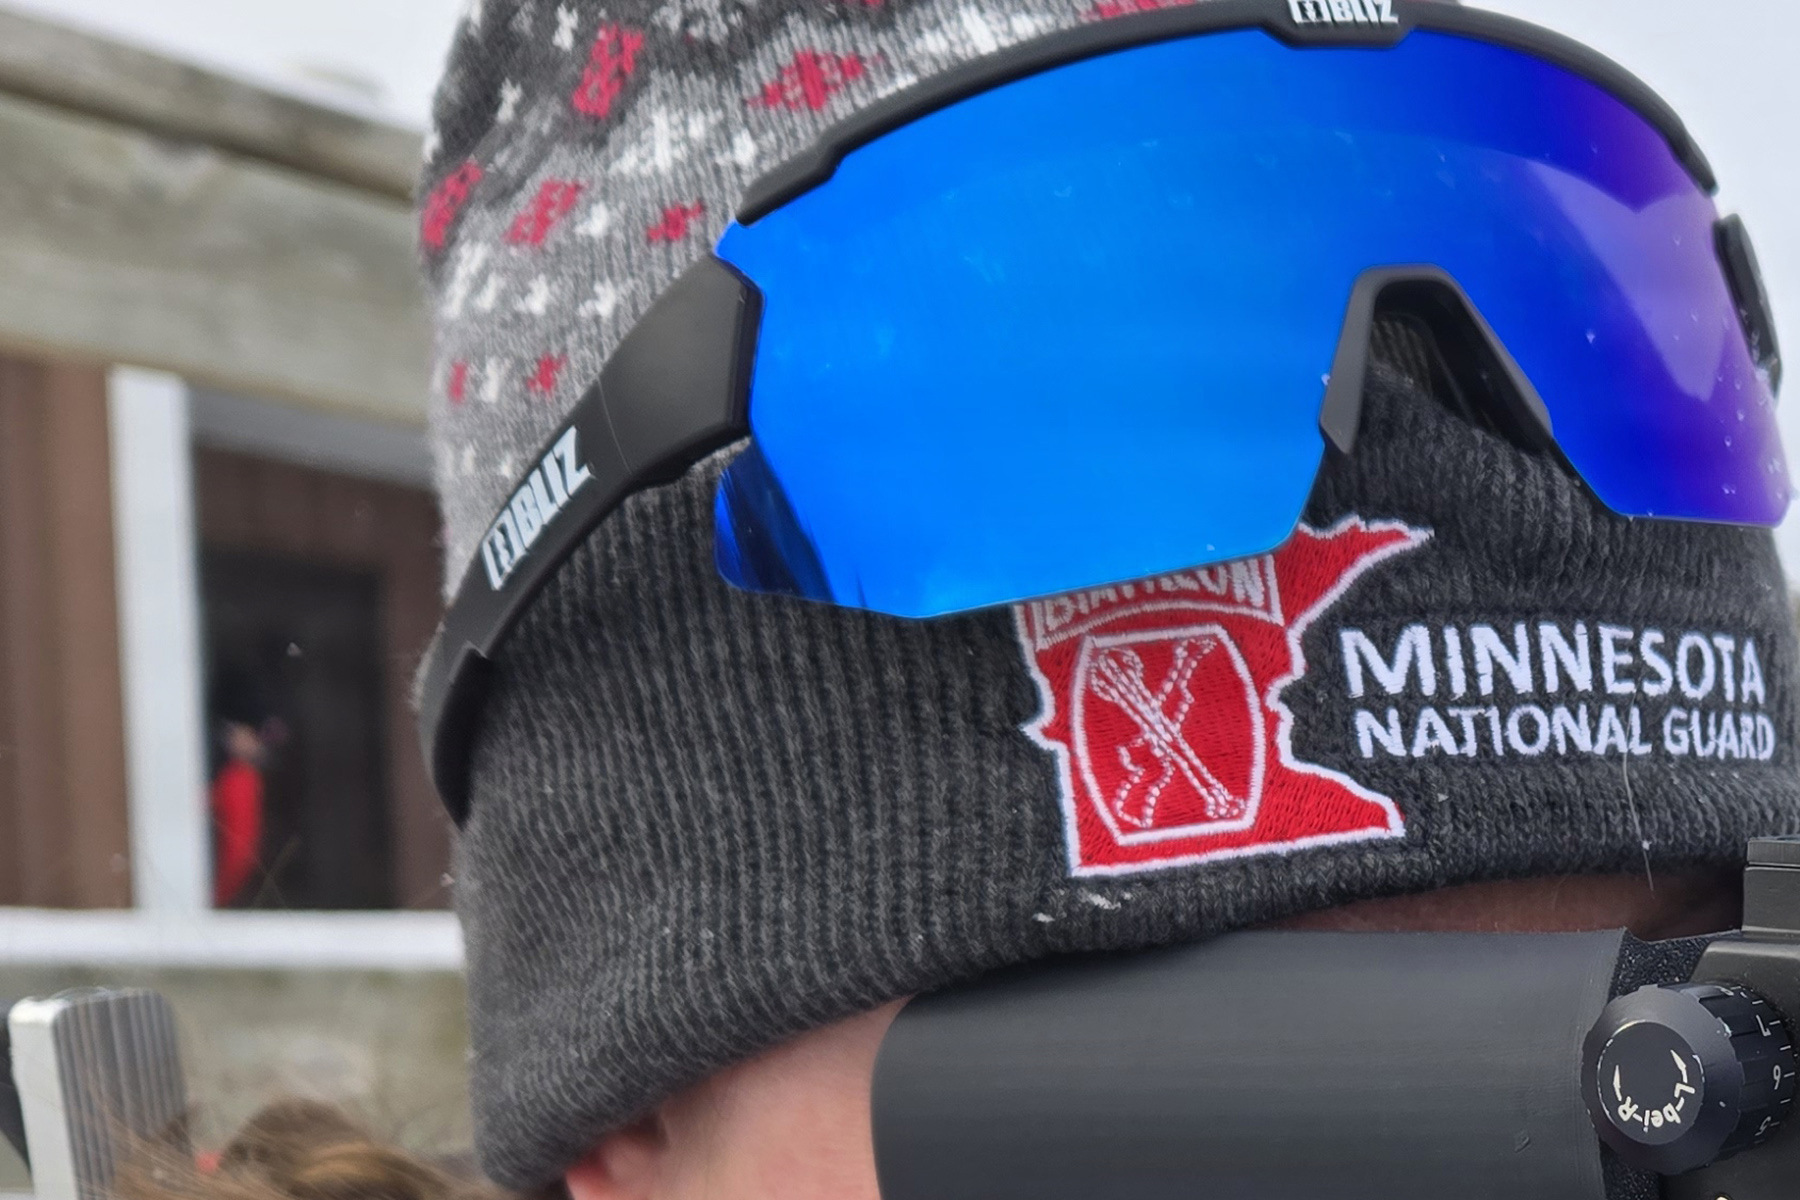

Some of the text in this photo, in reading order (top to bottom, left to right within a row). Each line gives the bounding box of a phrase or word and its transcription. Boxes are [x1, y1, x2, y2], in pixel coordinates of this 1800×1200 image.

[1339, 620, 1766, 704] MINNESOTA
[1354, 705, 1776, 760] NATIONAL GUARD
